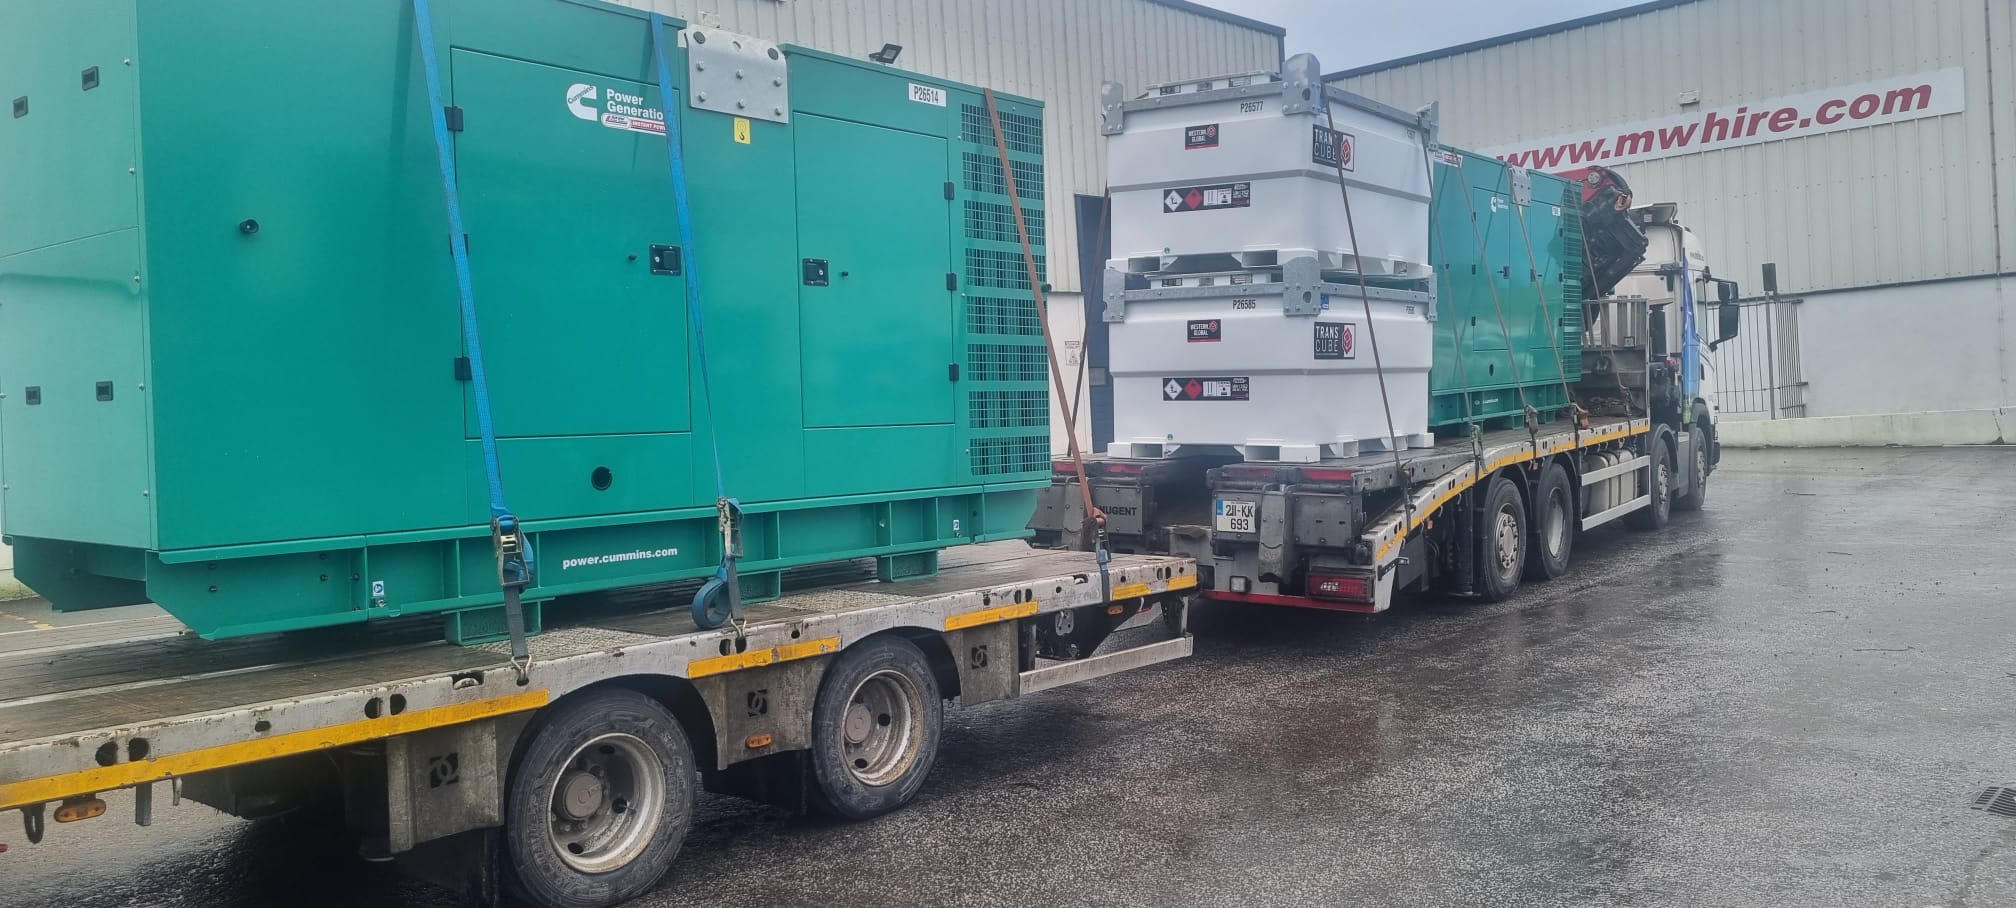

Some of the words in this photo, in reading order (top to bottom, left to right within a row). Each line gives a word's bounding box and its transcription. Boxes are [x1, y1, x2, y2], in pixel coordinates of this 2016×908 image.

[606, 88, 644, 106] Power
[914, 86, 939, 104] P26514
[607, 100, 664, 121] Generatio
[1240, 101, 1264, 113] P26577
[1188, 129, 1207, 137] WESTERN
[1496, 84, 1933, 170] www.mwhire.com
[1314, 128, 1336, 144] TRAN
[1232, 299, 1256, 310] P26585
[1315, 325, 1339, 339] TRANS
[1315, 339, 1339, 352] CUBE
[1230, 518, 1249, 531] 693
[562, 547, 678, 570] power.cummins.com
